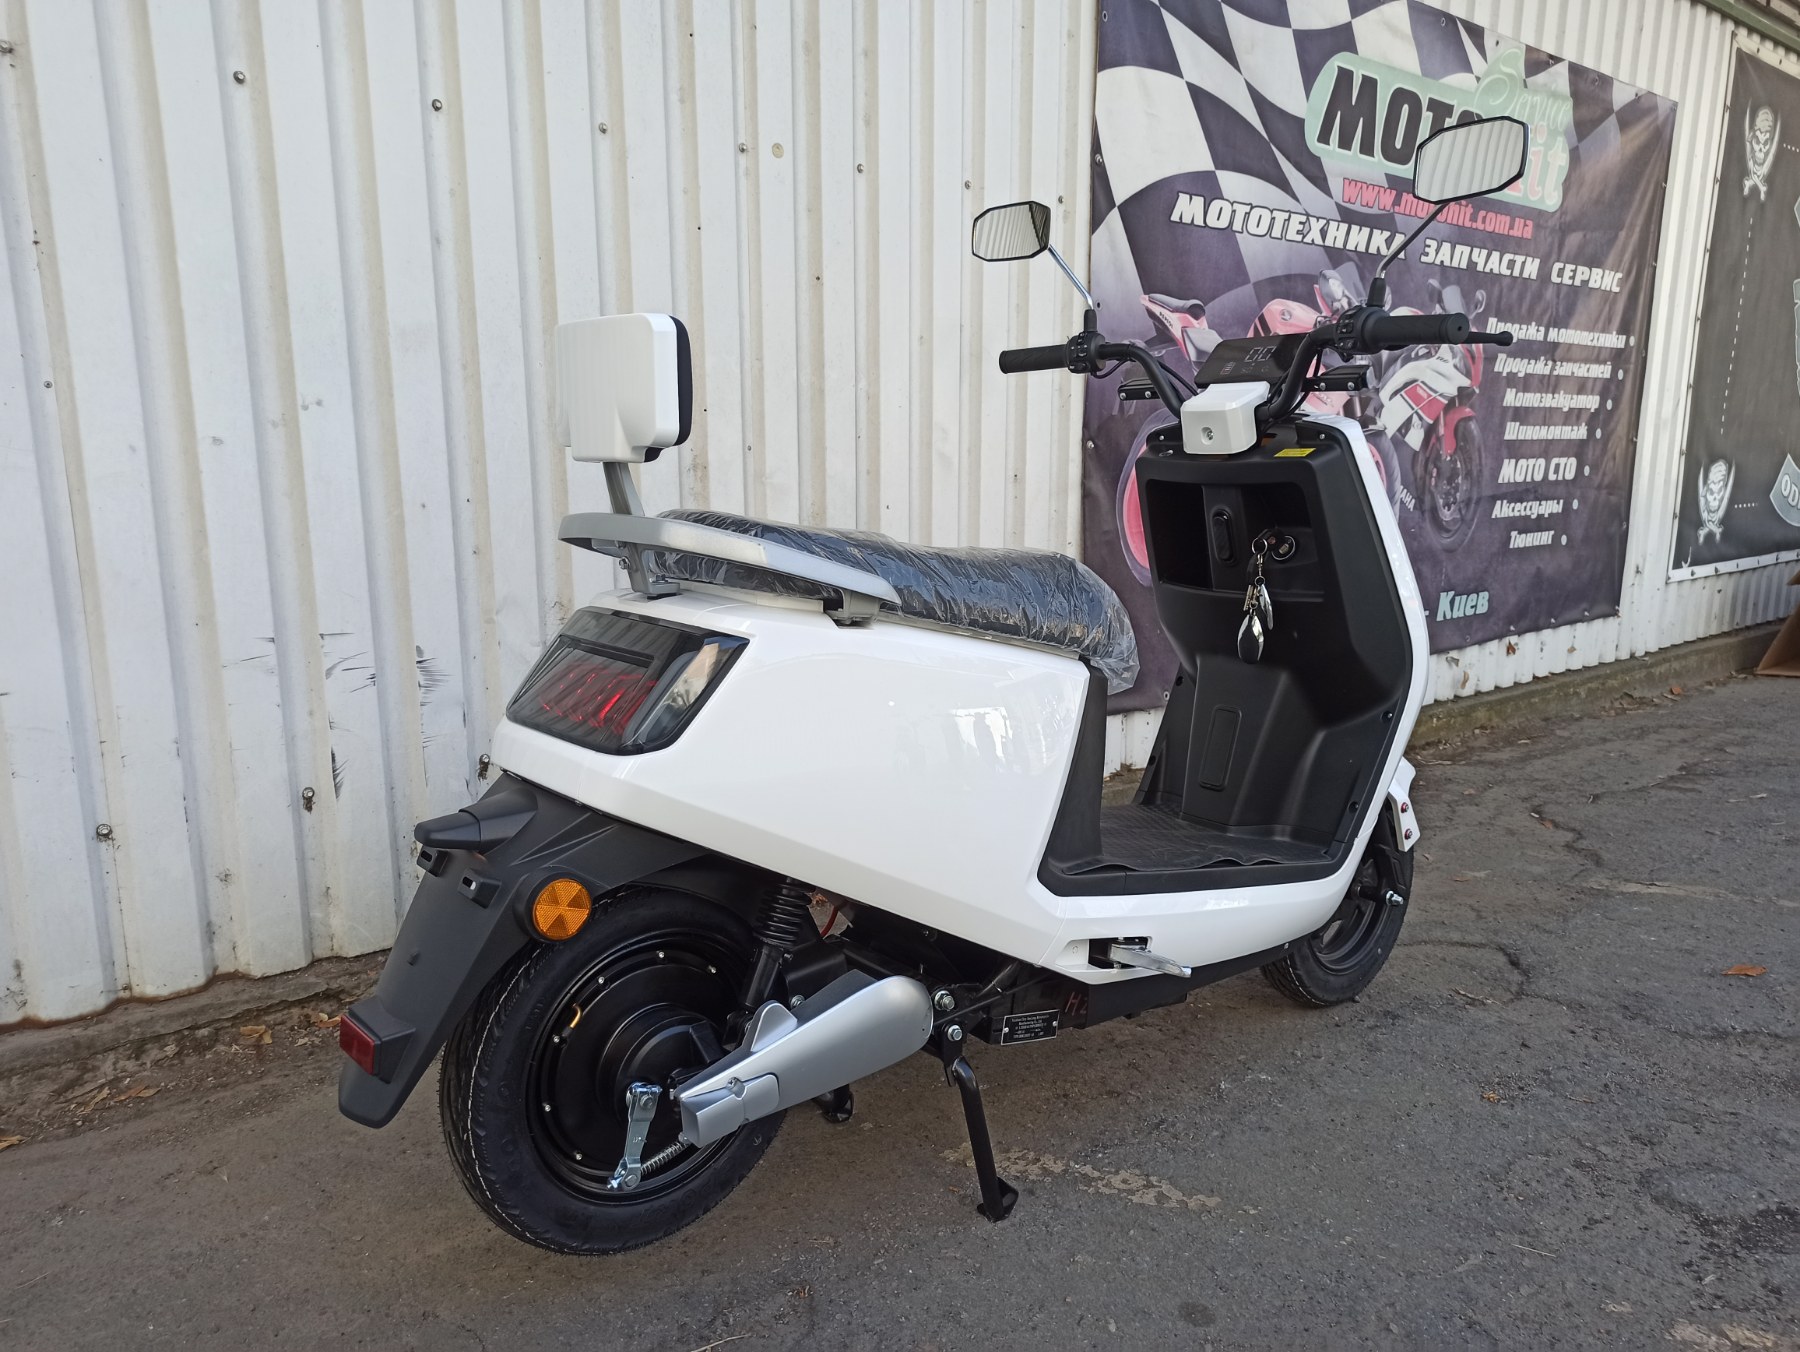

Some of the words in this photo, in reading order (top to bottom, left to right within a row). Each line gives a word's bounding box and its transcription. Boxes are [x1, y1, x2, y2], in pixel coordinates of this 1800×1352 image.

[1170, 192, 1406, 260] МОТОТЕХНИКА
[1420, 238, 1540, 281] ЗАПЧАСТИ
[1550, 261, 1623, 293] СЕРВИС
[1547, 327, 1627, 349] мототехники
[1494, 353, 1553, 378] Продажа
[1553, 361, 1612, 379] запчастей
[1504, 421, 1588, 440] Шиномонтаж
[1498, 458, 1546, 483] МОТО
[1548, 456, 1577, 481] СТО
[1491, 499, 1564, 519] Аксессуары
[1509, 530, 1555, 549] Тюнинг
[1436, 590, 1489, 621] Киев
